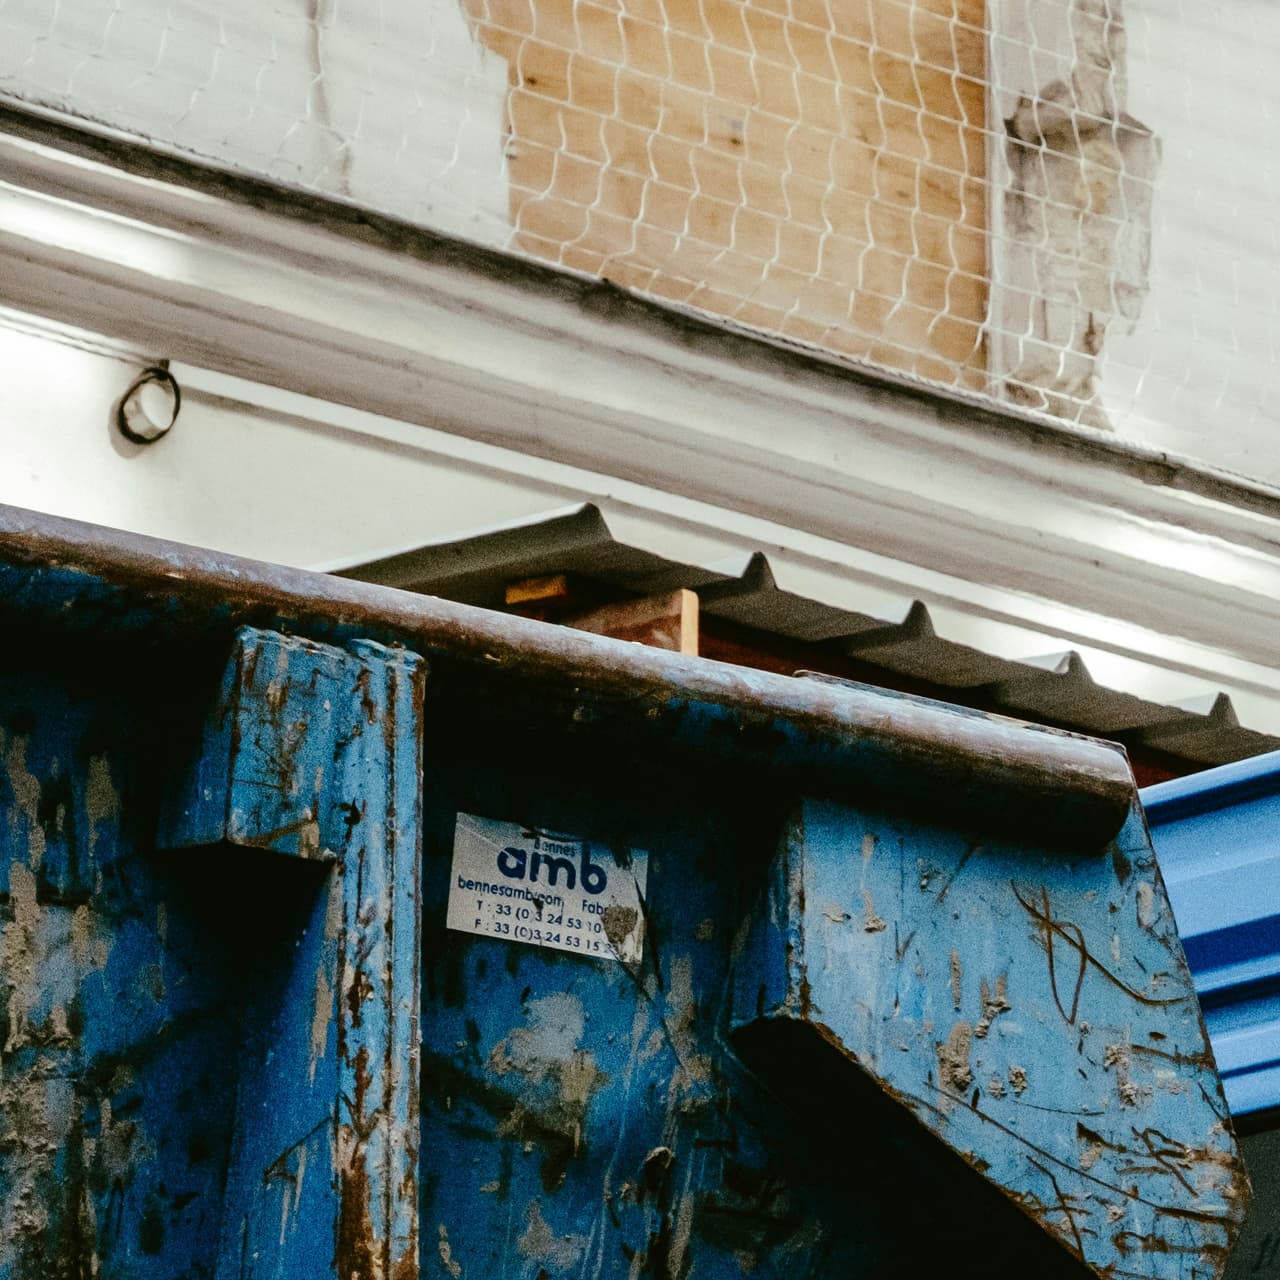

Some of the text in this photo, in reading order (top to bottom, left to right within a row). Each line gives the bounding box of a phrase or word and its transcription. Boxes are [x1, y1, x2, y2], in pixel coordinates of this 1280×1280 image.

[497, 842, 608, 895] amb
[477, 900, 484, 911] T
[495, 904, 512, 916] 33
[547, 914, 563, 926] 24
[566, 917, 582, 930] 53
[474, 918, 482, 929] F
[494, 922, 510, 935] 33
[545, 931, 561, 944] 24
[565, 936, 580, 948] 53
[586, 939, 600, 951] 15
